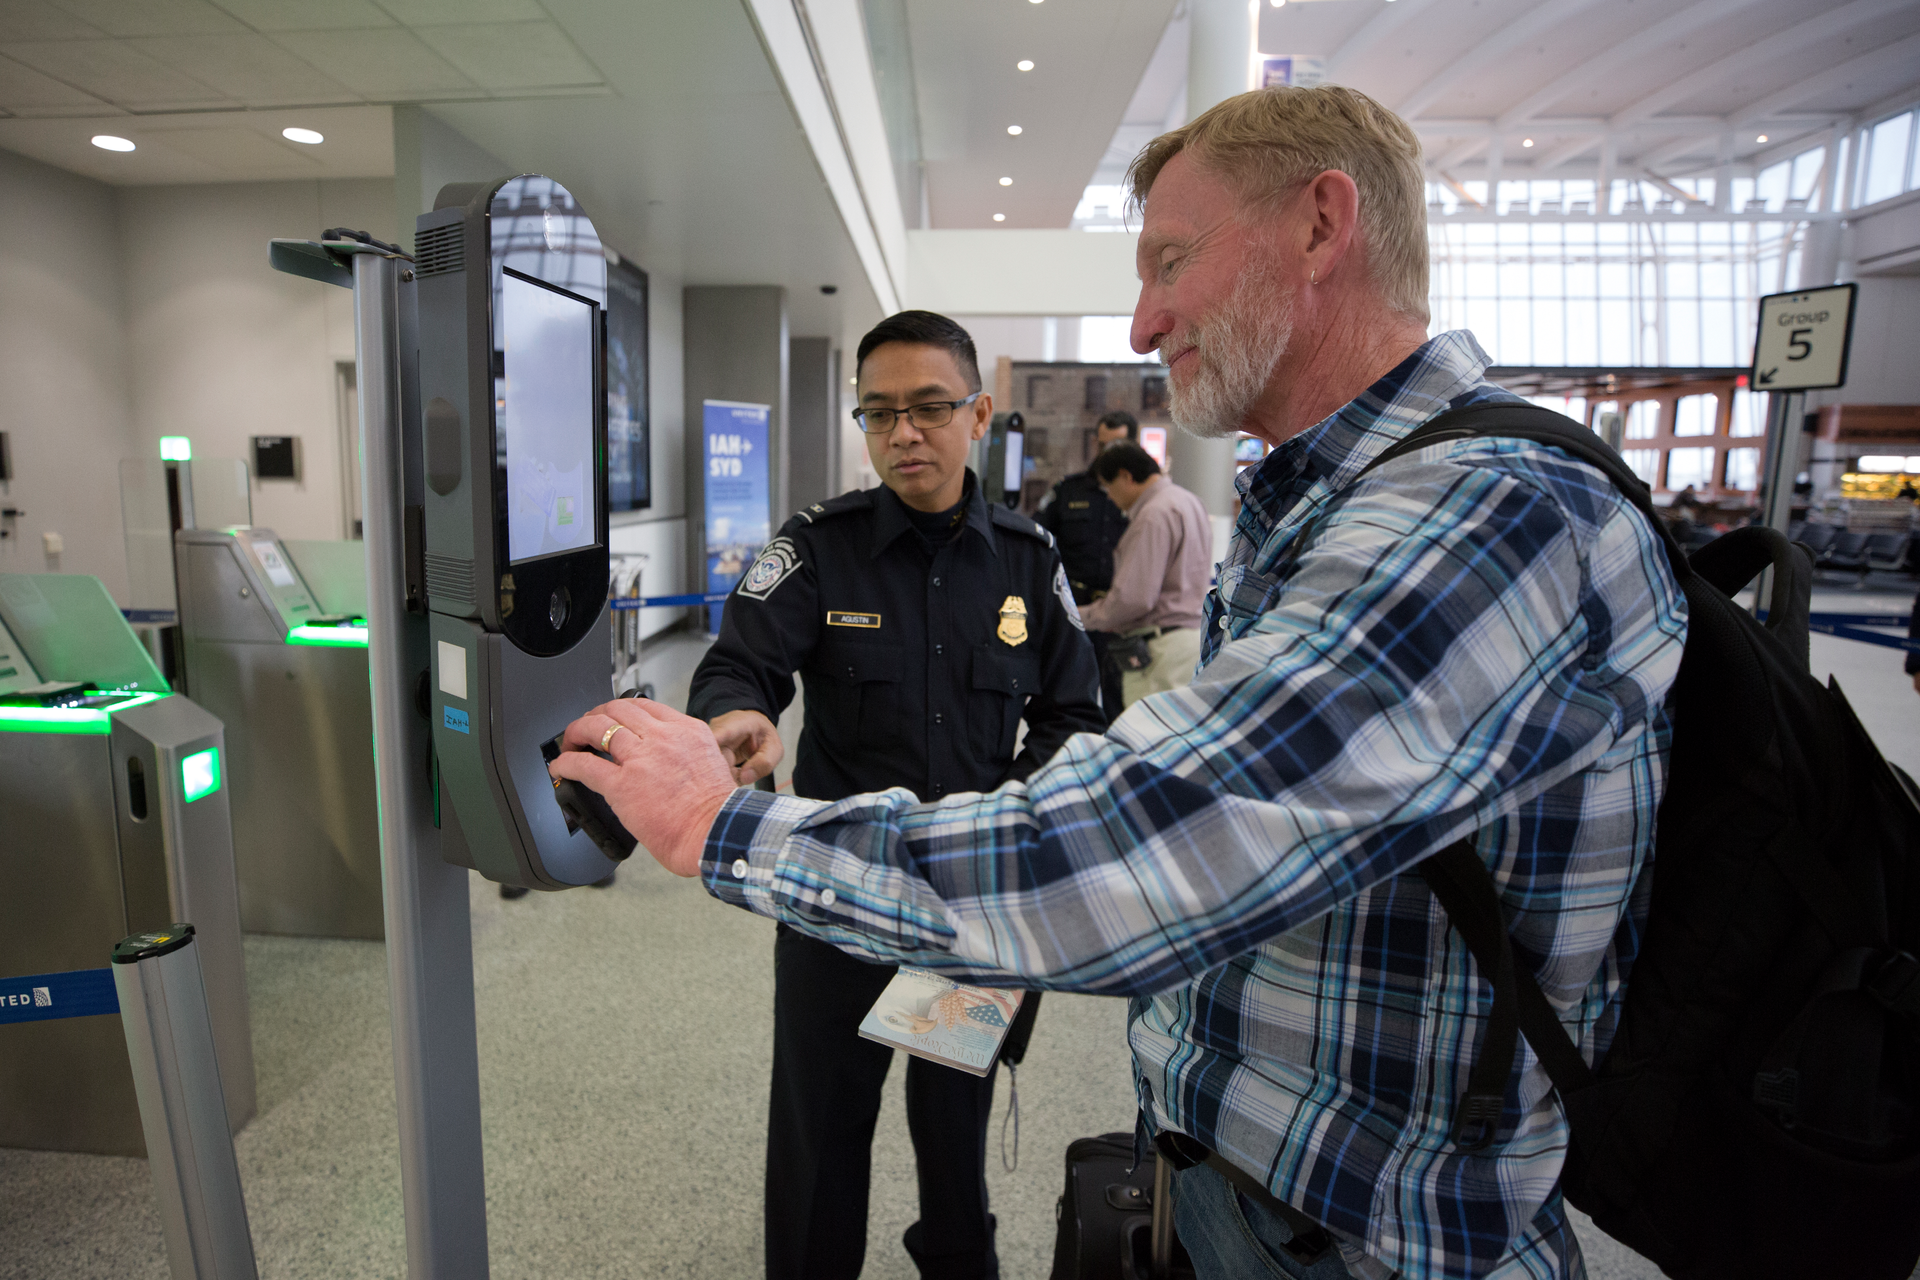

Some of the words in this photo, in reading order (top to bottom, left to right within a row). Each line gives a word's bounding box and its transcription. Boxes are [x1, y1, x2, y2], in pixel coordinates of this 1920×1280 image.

[1778, 310, 1830, 326] Group
[1786, 328, 1813, 361] 5
[709, 456, 743, 477] SYD
[840, 615, 869, 624] AGUSTIN
[909, 1034, 950, 1055] People
[966, 1051, 985, 1066] We
